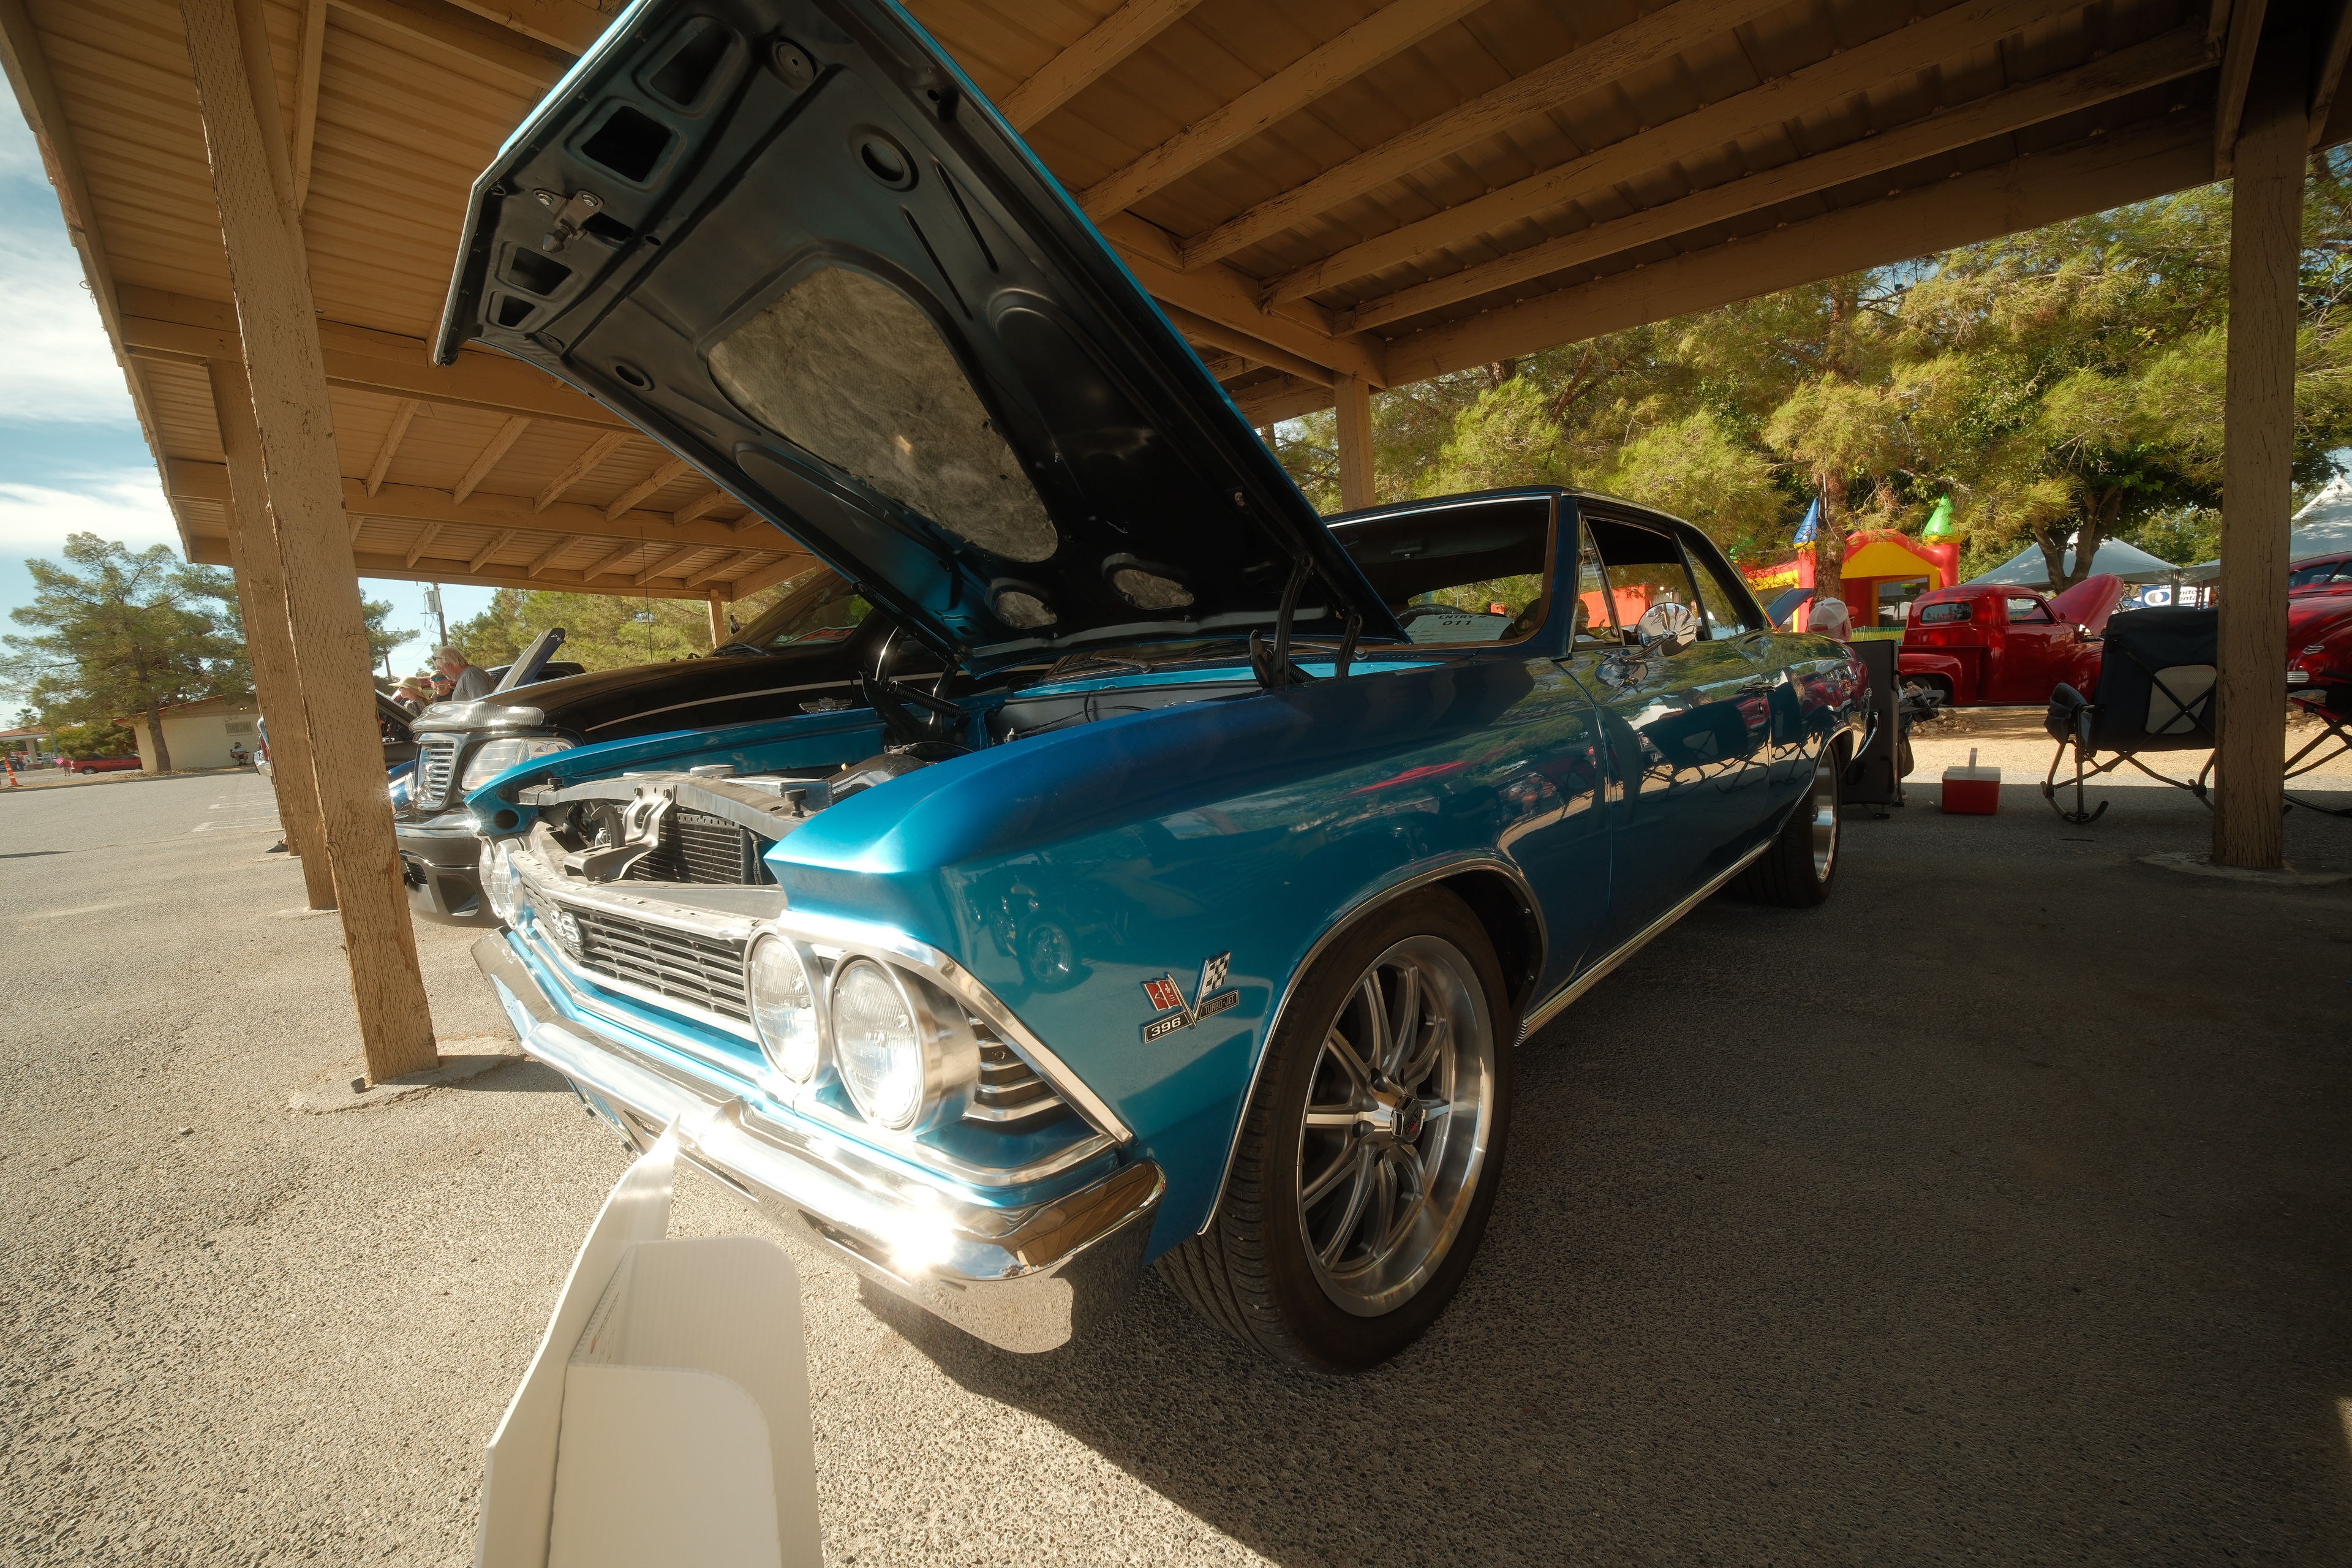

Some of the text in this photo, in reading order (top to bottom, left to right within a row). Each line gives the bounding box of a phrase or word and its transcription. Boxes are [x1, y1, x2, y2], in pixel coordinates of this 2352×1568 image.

[550, 910, 581, 942] SS
[1204, 995, 1235, 1015] TURBO-JET
[1151, 1017, 1182, 1037] 396
